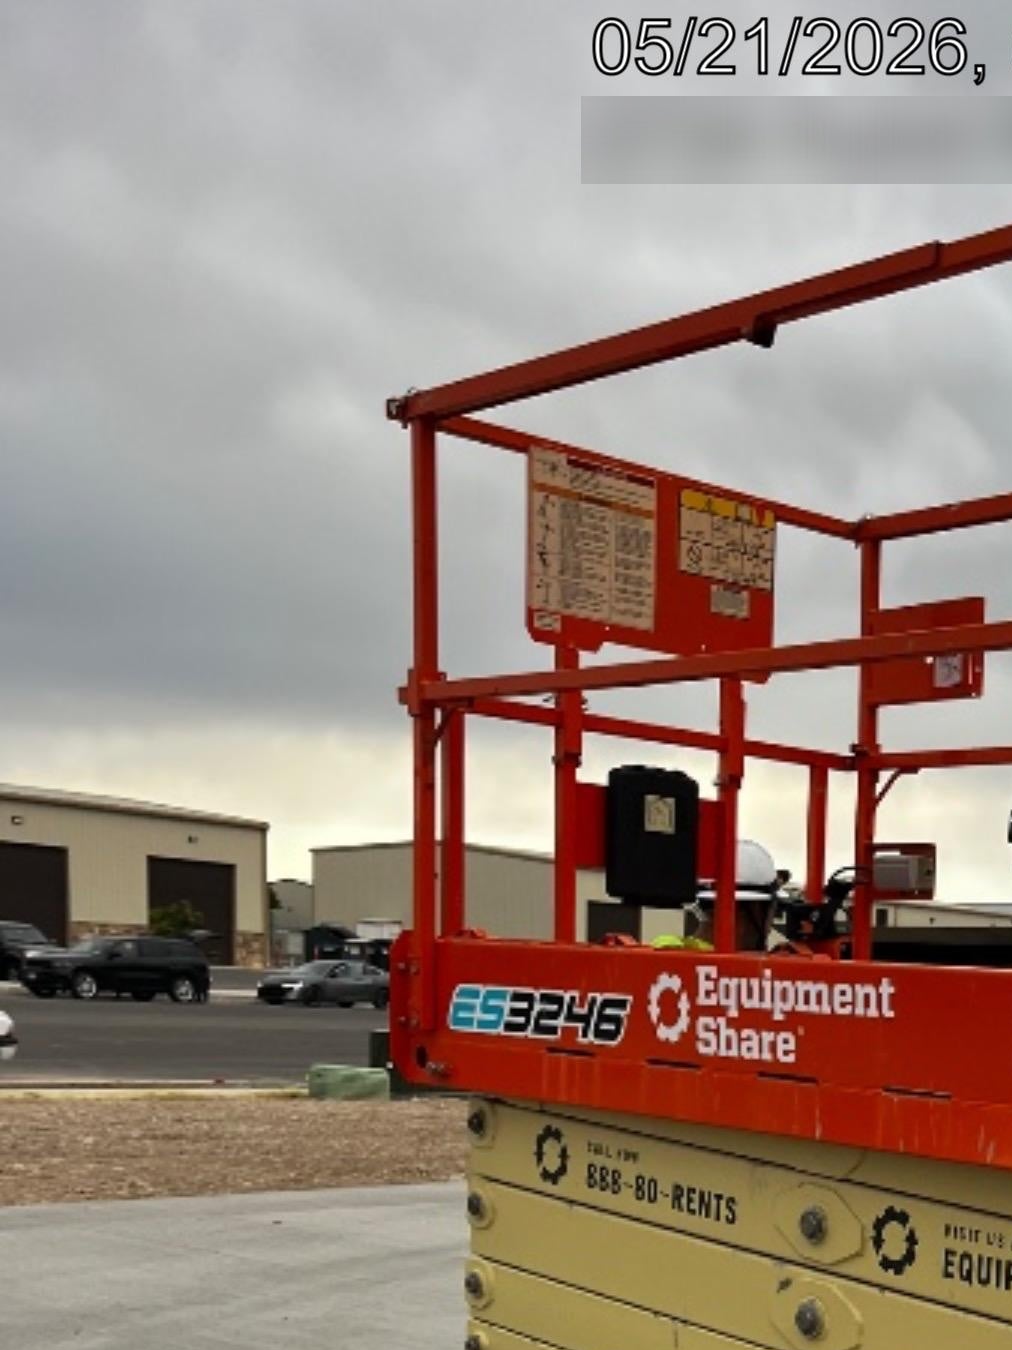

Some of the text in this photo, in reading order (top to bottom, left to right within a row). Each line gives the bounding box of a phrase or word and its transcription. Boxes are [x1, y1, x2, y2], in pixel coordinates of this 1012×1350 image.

[447, 983, 632, 1045] ES3246
[696, 965, 895, 1020] Equipment
[697, 1016, 796, 1063] Share
[586, 1163, 737, 1225] 888-80-RENTS
